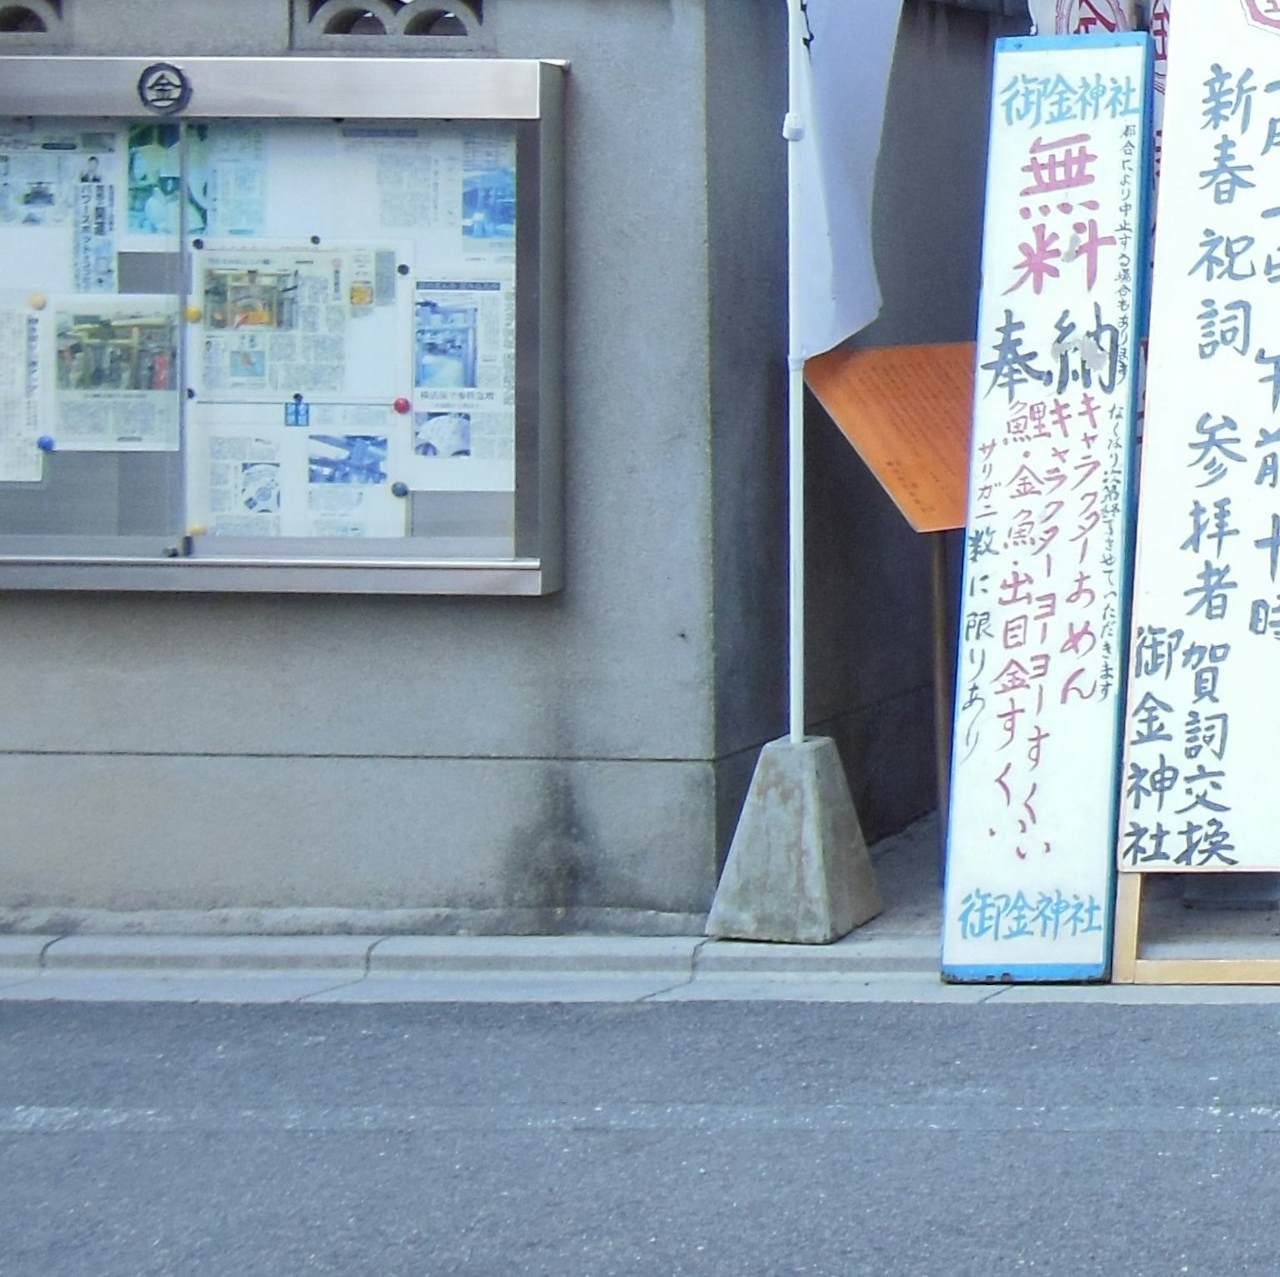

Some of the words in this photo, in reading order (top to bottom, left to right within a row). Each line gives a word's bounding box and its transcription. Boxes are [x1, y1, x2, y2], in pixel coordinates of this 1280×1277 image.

[148, 72, 183, 107] 金
[1000, 72, 1141, 129] 御金神社
[1001, 133, 1117, 297] 無料
[1113, 124, 1137, 385] 都合により中止する場合もあります
[980, 303, 1119, 403] 奉納
[1123, 624, 1185, 867] 御金神社
[959, 889, 1105, 942] 御金神社
